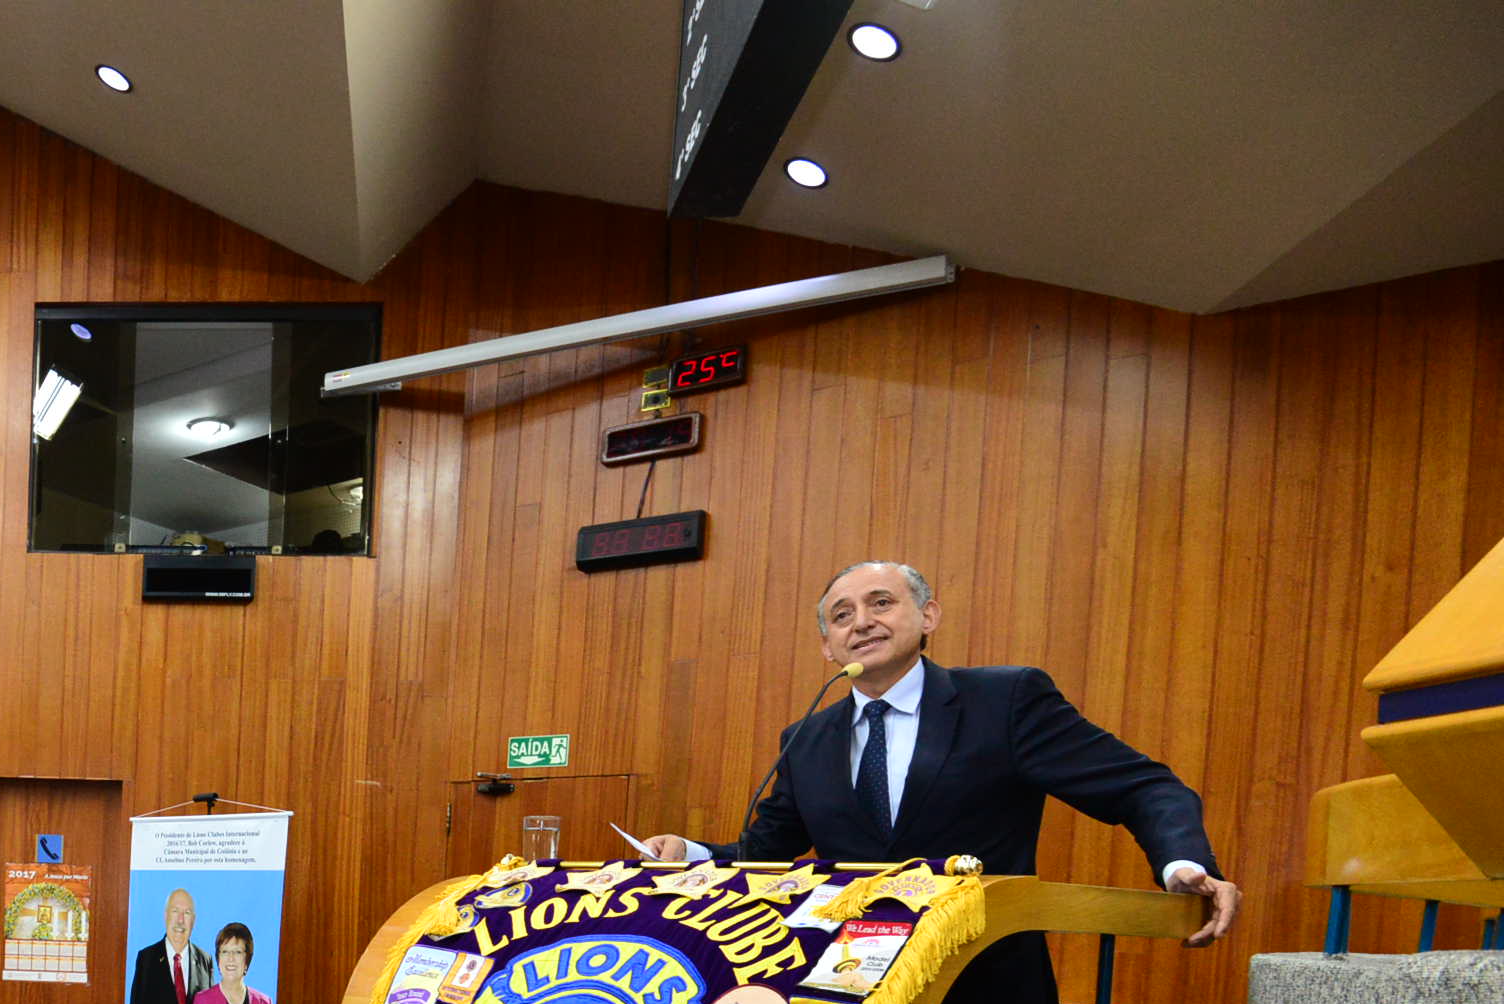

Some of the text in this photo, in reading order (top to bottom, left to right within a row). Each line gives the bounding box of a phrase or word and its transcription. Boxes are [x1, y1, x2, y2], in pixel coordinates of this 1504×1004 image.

[511, 738, 549, 756] SAÍDA
[8, 870, 37, 879] 2017
[846, 923, 858, 933] We
[857, 925, 876, 934] Lead
[878, 926, 890, 934] the
[474, 887, 807, 986] LIONS CLUBE
